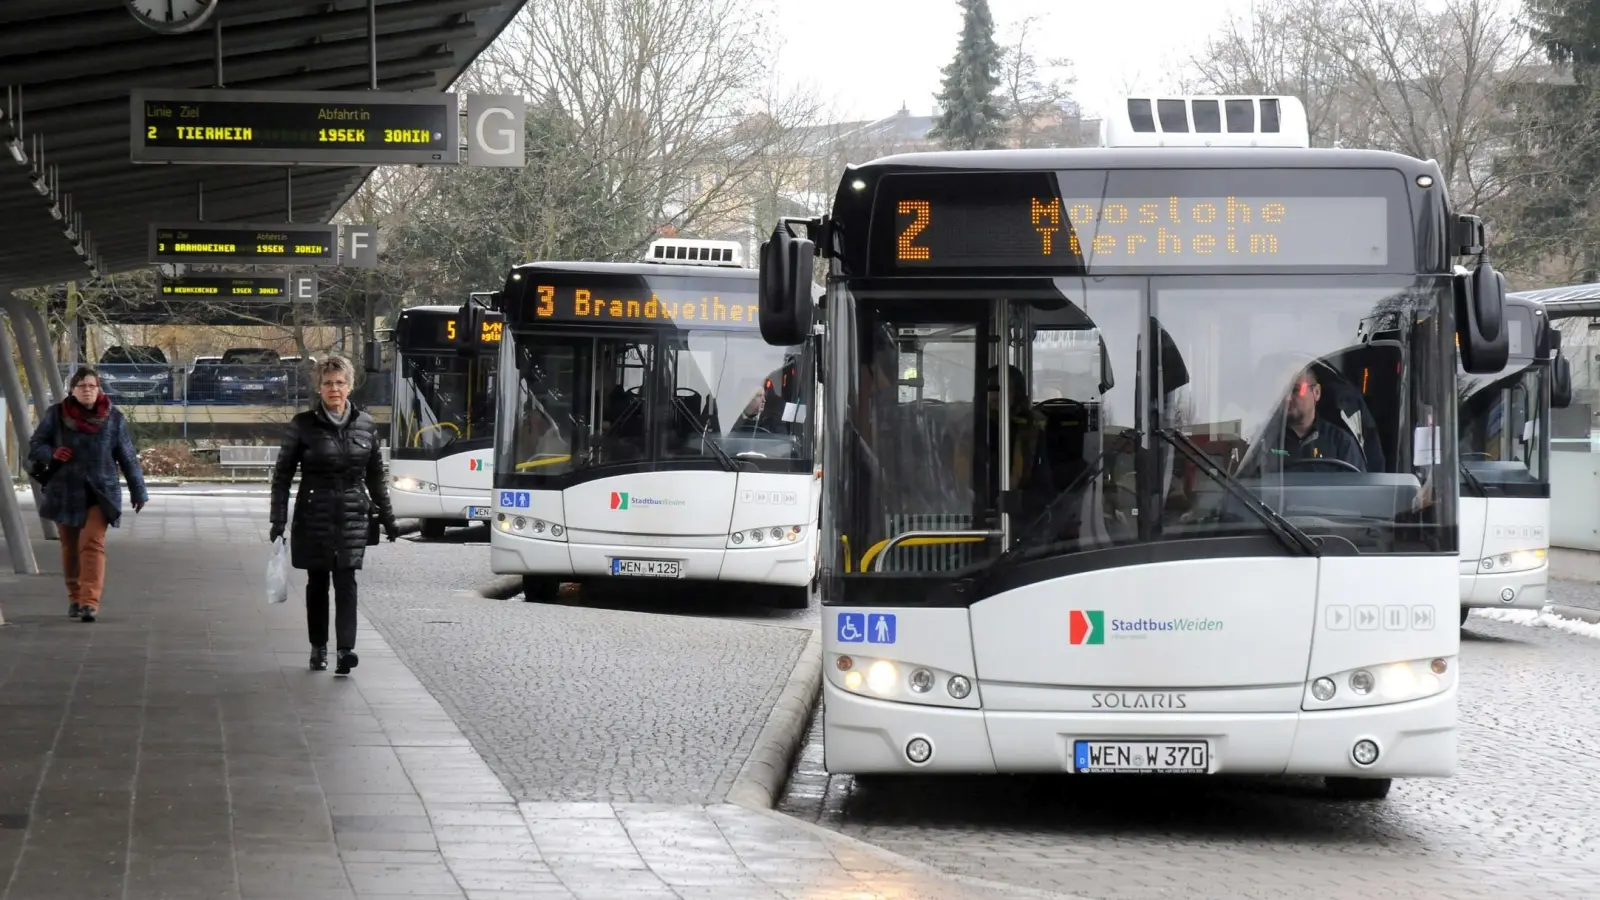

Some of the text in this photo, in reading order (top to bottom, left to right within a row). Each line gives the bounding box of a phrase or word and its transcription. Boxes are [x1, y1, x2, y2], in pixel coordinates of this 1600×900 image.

[147, 104, 172, 118] Linie
[180, 105, 200, 118] Ziel
[318, 108, 358, 121] Abfahrt
[147, 126, 157, 139] 2
[176, 126, 253, 141] TIERHEIM
[383, 130, 431, 143] 30MIN
[475, 107, 516, 155] G
[898, 196, 1286, 260] 2 Mooslohe
[159, 243, 165, 252] 3
[351, 232, 369, 259] F
[1035, 226, 1279, 256] Tierheim
[298, 278, 312, 298] E
[537, 286, 759, 321] 3 Brandweiher
[447, 320, 457, 340] 5
[620, 561, 677, 574] WEN W 125
[1111, 618, 1224, 631] StadtbusWeiden
[1092, 693, 1187, 708] SOLARIS
[1089, 746, 1204, 767] WEN W 370
